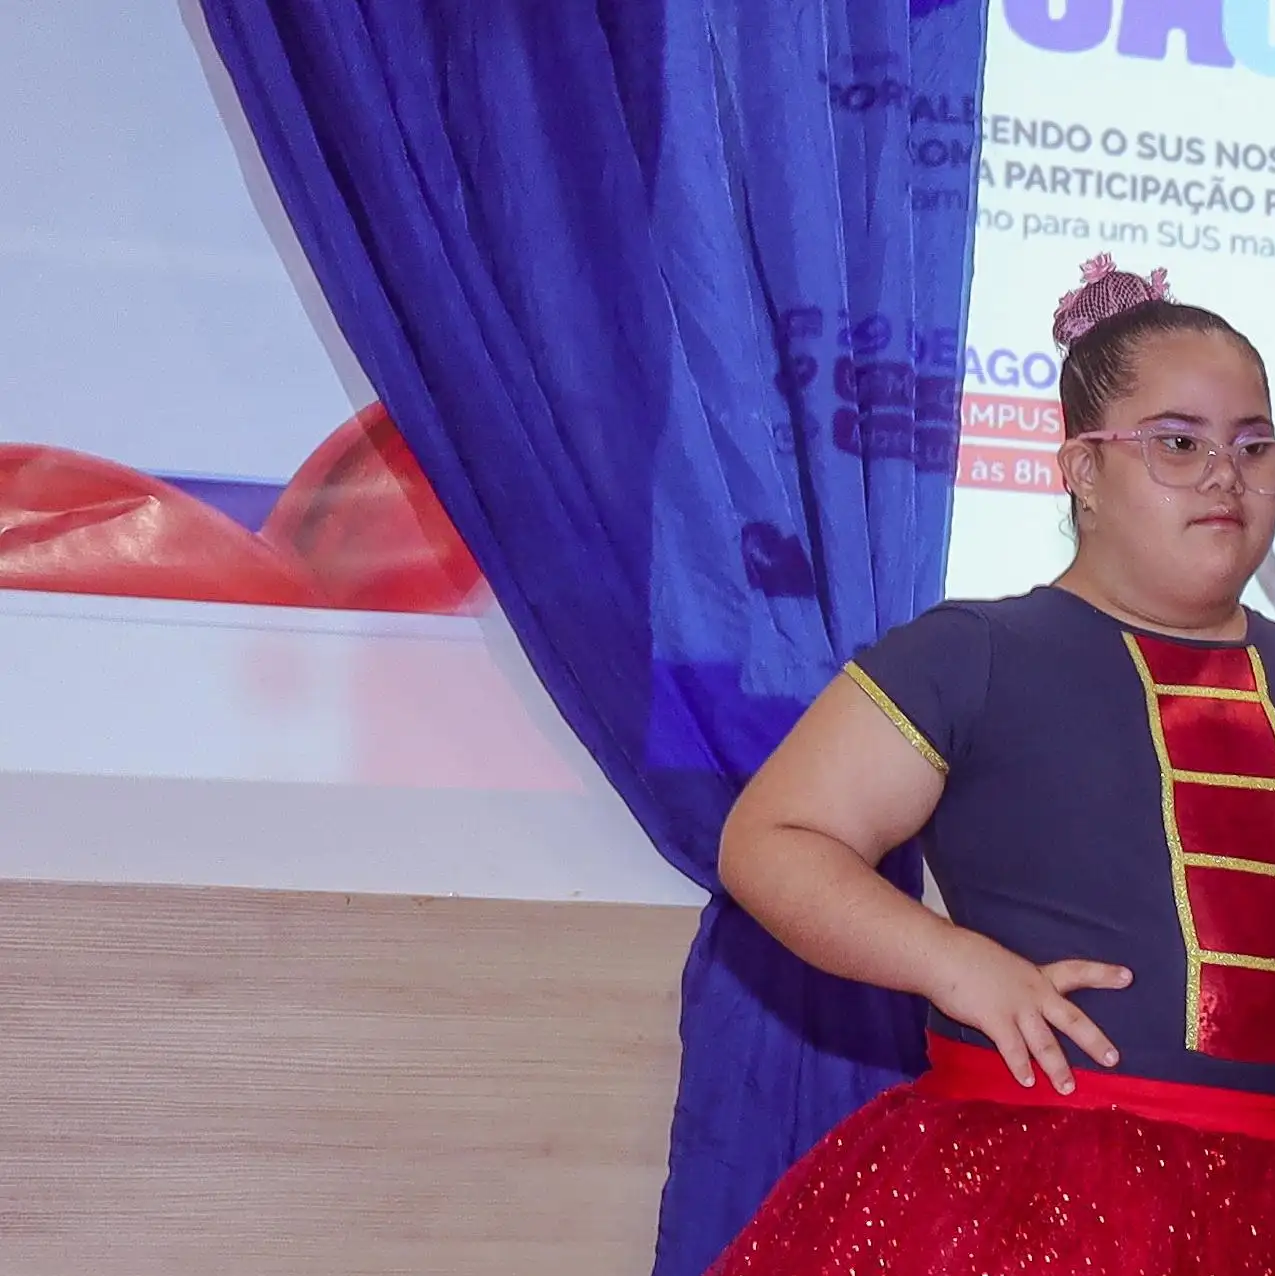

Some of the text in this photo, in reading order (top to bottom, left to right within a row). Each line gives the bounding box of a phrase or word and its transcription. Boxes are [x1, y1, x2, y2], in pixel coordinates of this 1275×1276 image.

[1101, 127, 1128, 156] O
[1136, 131, 1206, 166] SUS
[1004, 160, 1256, 215] PARTICIPAÇÃO
[1022, 212, 1091, 240] para
[1099, 221, 1149, 245] um
[1157, 220, 1221, 252] SUS
[962, 402, 1060, 434] MPUS
[1014, 459, 1053, 488] 8h
